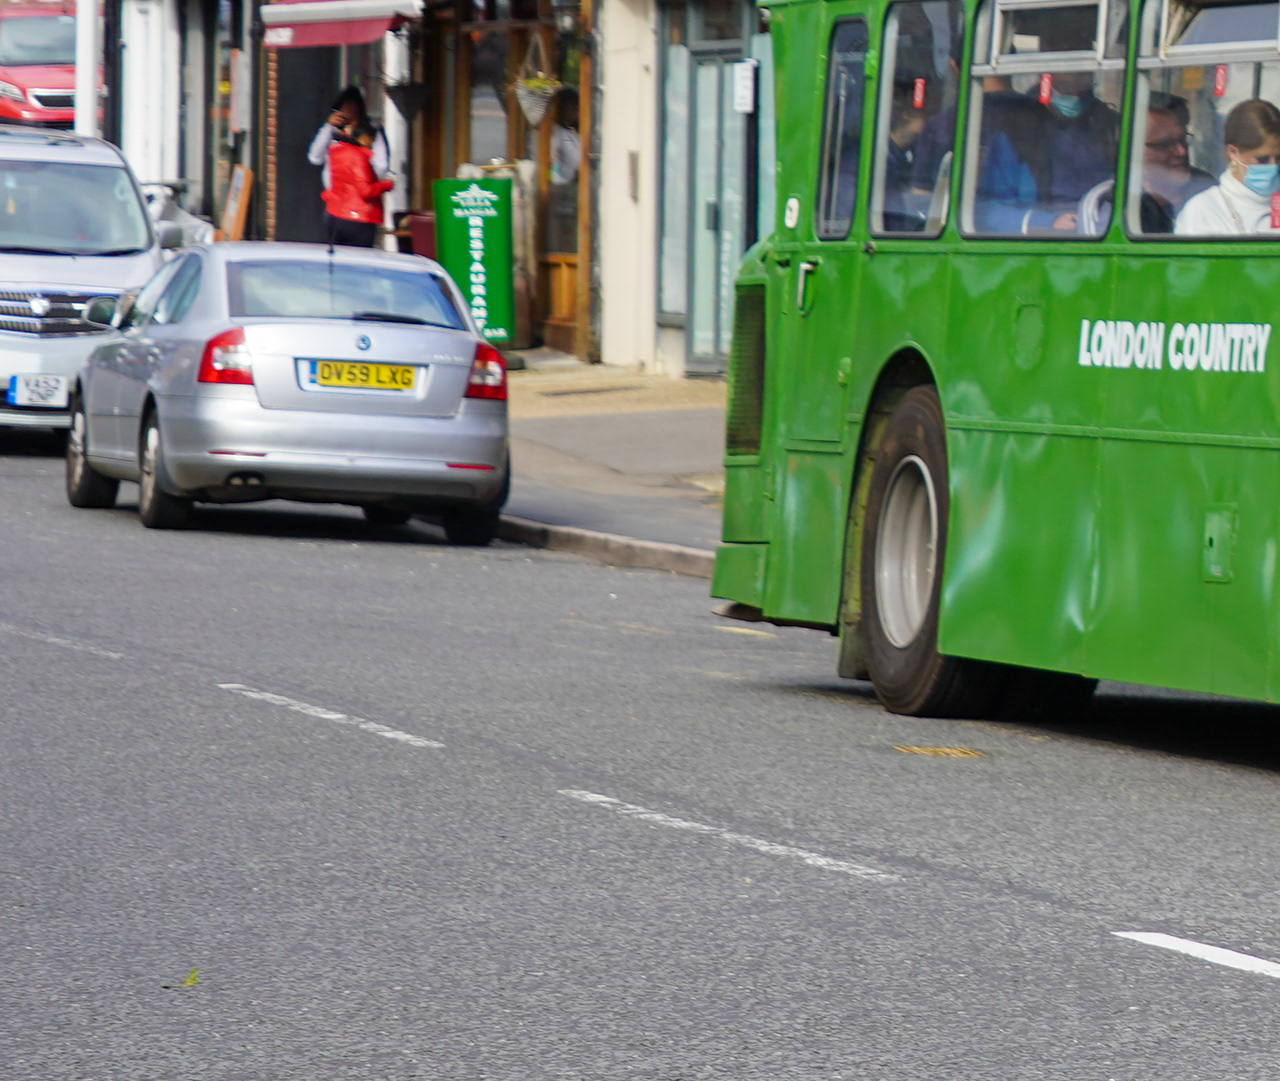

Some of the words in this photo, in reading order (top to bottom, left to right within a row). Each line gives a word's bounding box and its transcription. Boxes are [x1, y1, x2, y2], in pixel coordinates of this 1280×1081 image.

[468, 216, 488, 331] RESTAURANT
[1079, 319, 1165, 370] LONDON
[1168, 322, 1272, 372] COUNTRY
[375, 366, 414, 386] LXG
